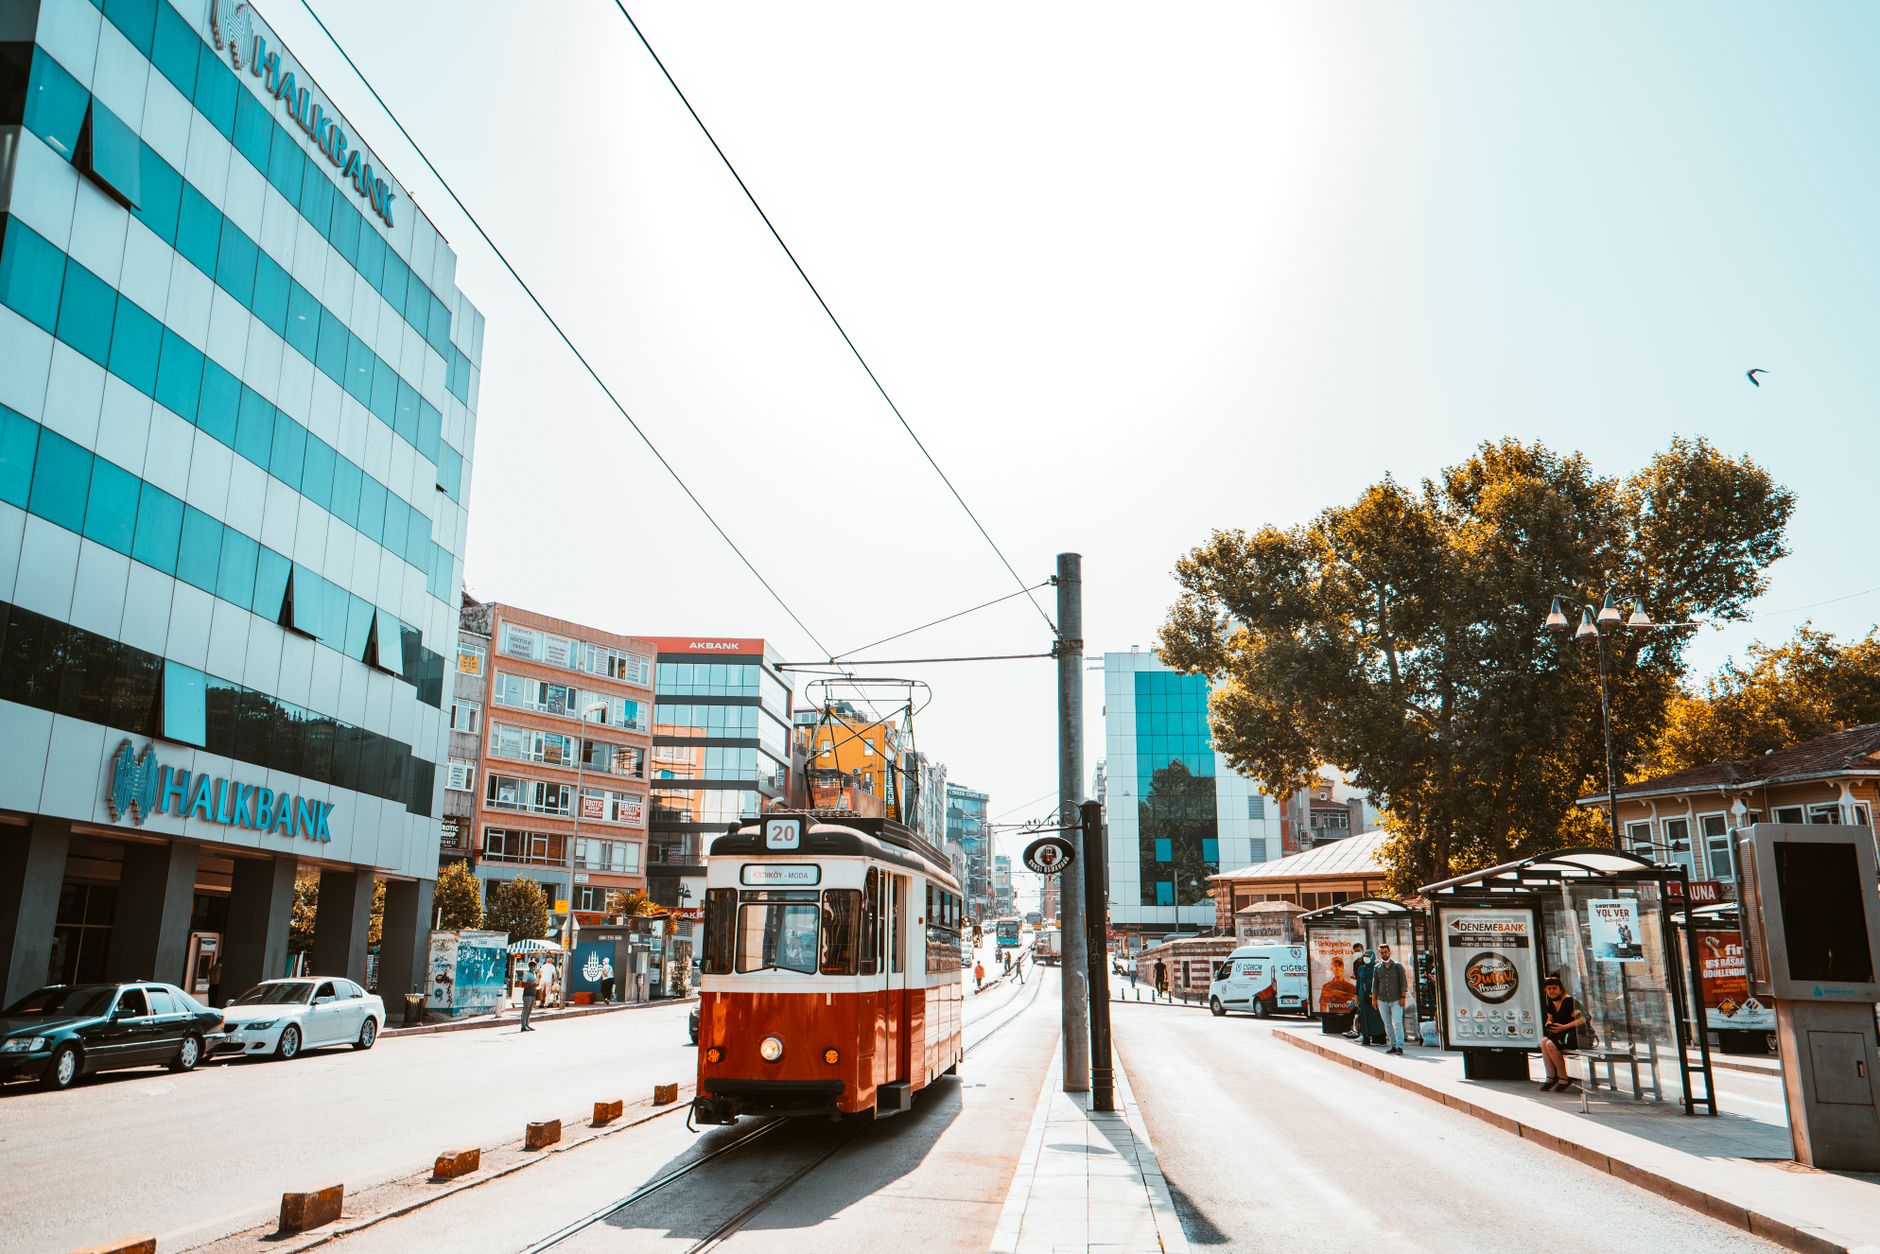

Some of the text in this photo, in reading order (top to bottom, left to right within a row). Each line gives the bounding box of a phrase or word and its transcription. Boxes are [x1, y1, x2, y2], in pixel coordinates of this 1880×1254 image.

[252, 35, 396, 229] HALKBANK
[689, 642, 739, 650] AKBANK
[157, 765, 335, 843] HALKBANK
[772, 825, 795, 841] 20
[1596, 909, 1630, 917] YOL VER
[1460, 923, 1524, 932] DENEMEBANK
